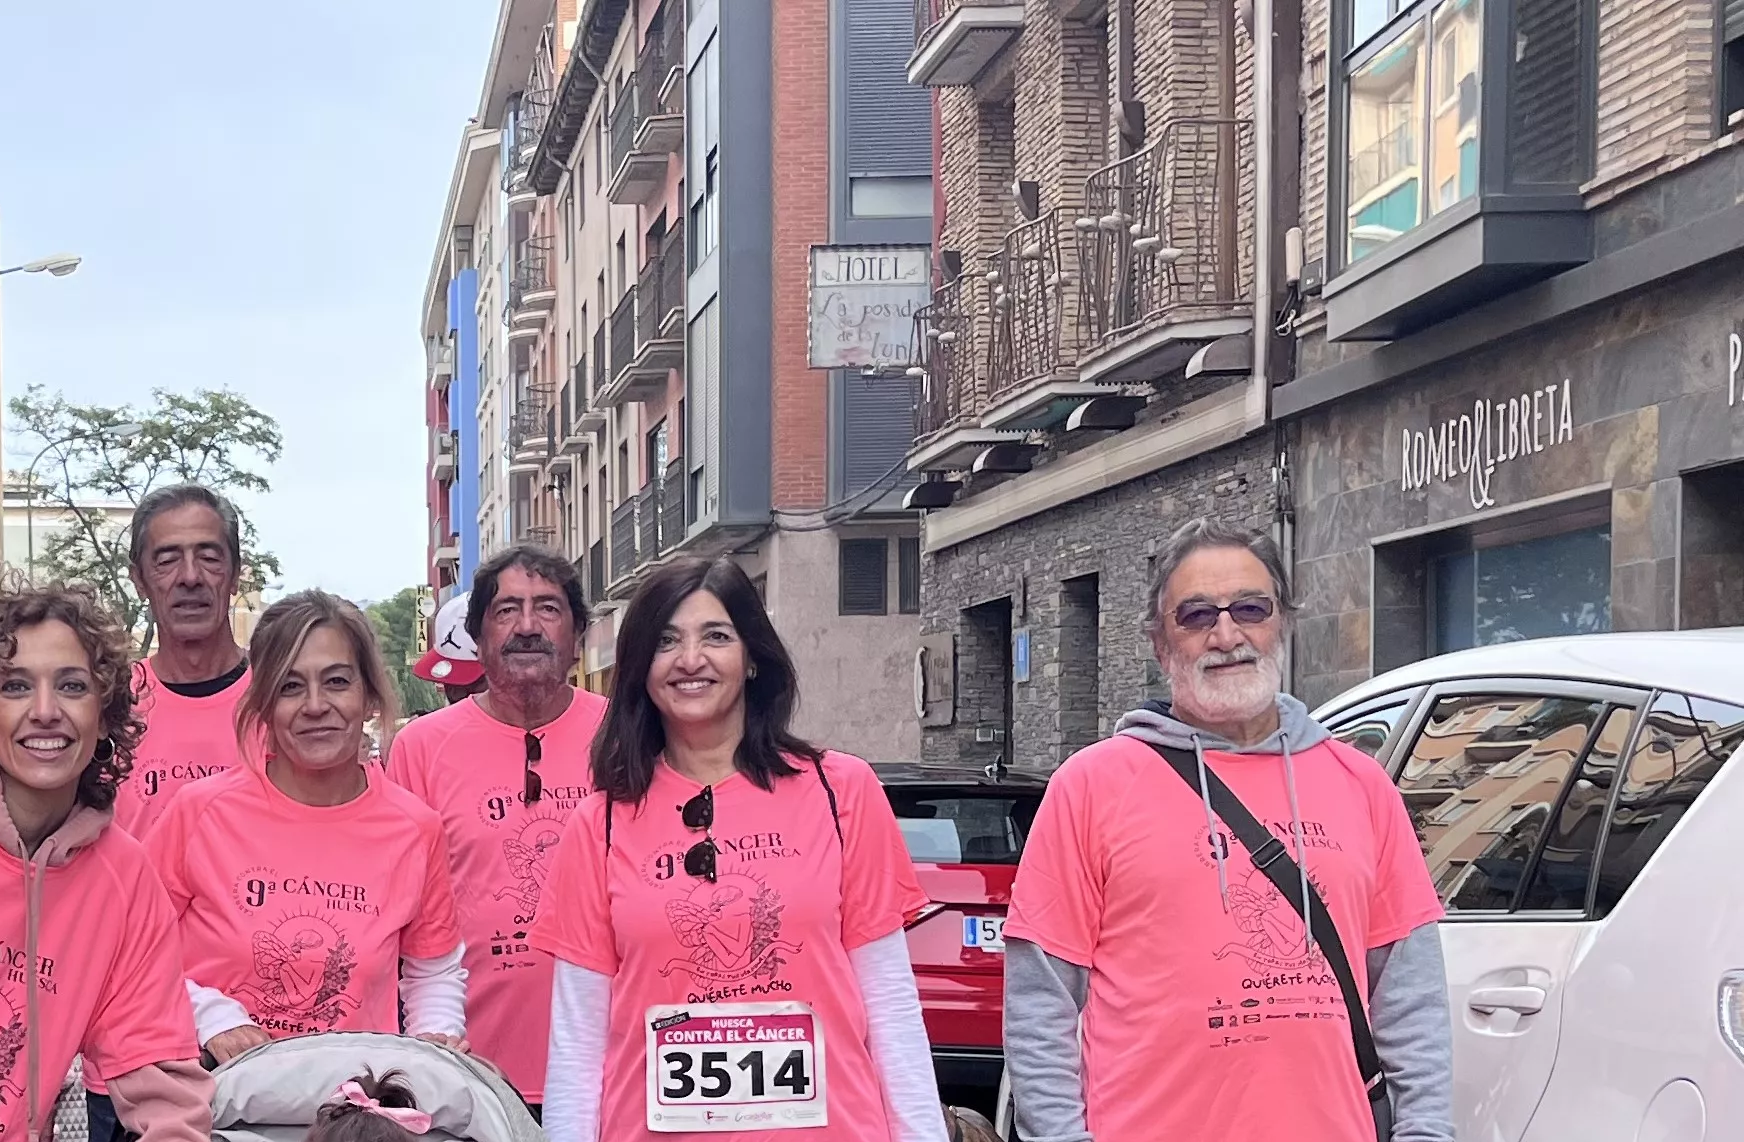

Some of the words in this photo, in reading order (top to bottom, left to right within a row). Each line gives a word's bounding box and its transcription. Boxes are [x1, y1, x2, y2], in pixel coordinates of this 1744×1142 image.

[836, 255, 906, 282] HOTEL
[871, 332, 909, 360] lun
[1729, 333, 1744, 407] P
[171, 760, 233, 779] CÁNC
[517, 786, 588, 803] CNCER
[740, 847, 802, 863] HUESCA
[245, 878, 277, 907] 9ª
[283, 875, 367, 902] CÁNCER
[326, 898, 381, 917] HUESCA
[982, 920, 1005, 941] 5
[7, 968, 58, 995] HUSCA
[1242, 973, 1303, 989] QUIÉRETE
[687, 984, 748, 1004] QUIÉRETE
[751, 980, 792, 995] MUCHO
[711, 1018, 754, 1029] HUESCA
[664, 1030, 718, 1043] CONTRA
[726, 1029, 744, 1042] EL
[745, 1026, 806, 1041] CÁNCER
[663, 1049, 810, 1099] 3514
